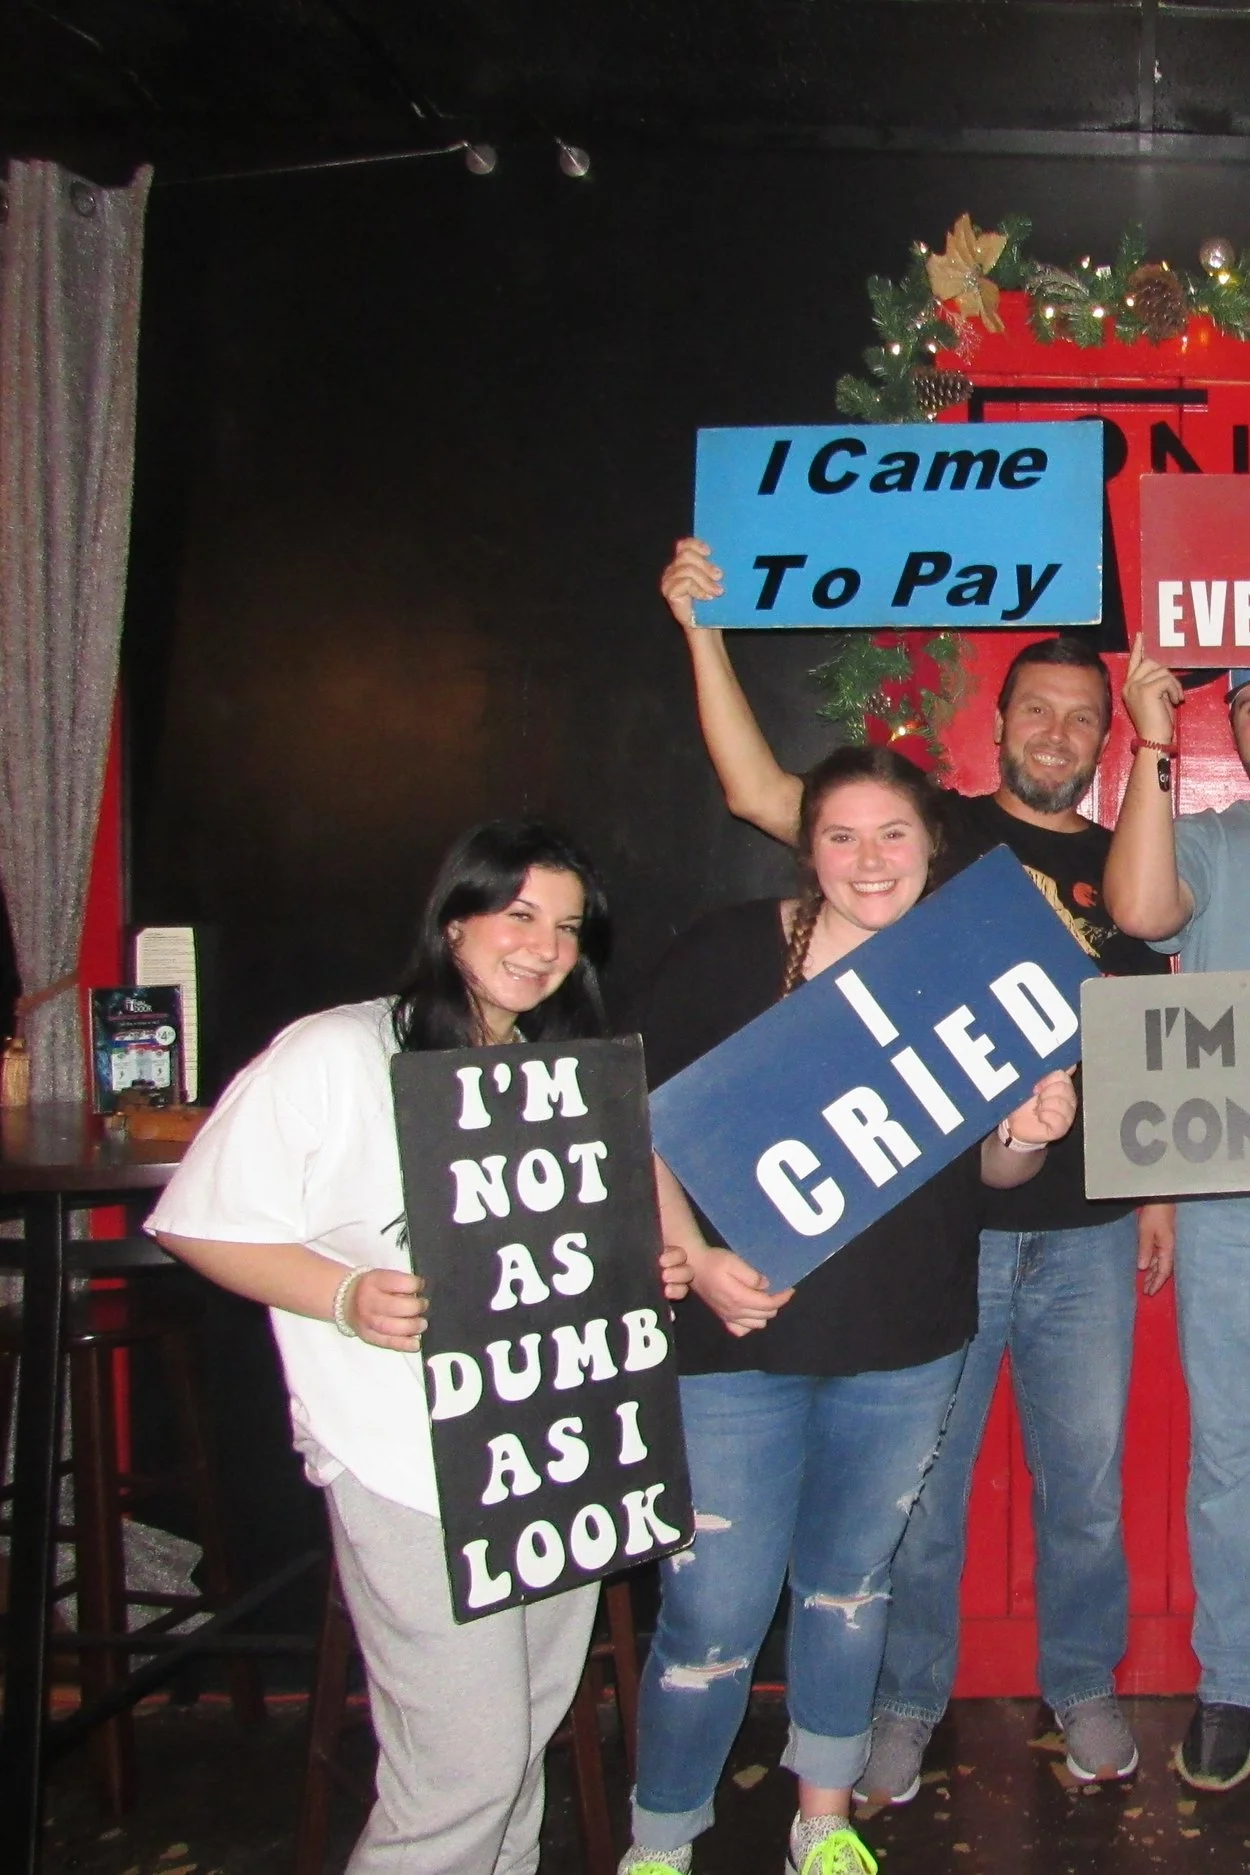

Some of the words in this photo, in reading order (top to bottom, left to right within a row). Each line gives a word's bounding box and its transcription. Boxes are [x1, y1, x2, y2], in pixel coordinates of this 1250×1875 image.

[758, 440, 792, 495] I
[808, 437, 1048, 494] Came
[752, 554, 862, 610] To
[891, 551, 1062, 621] Pay
[834, 968, 900, 1048] I
[1144, 1005, 1236, 1071] I'M
[456, 1056, 588, 1130] I'M
[755, 961, 1079, 1237] CRIED
[449, 1140, 608, 1224] NOT
[490, 1232, 594, 1311] AS
[427, 1308, 669, 1420] DUMB
[482, 1416, 590, 1505] AS
[615, 1401, 648, 1465] I
[462, 1483, 681, 1609] LOOK
